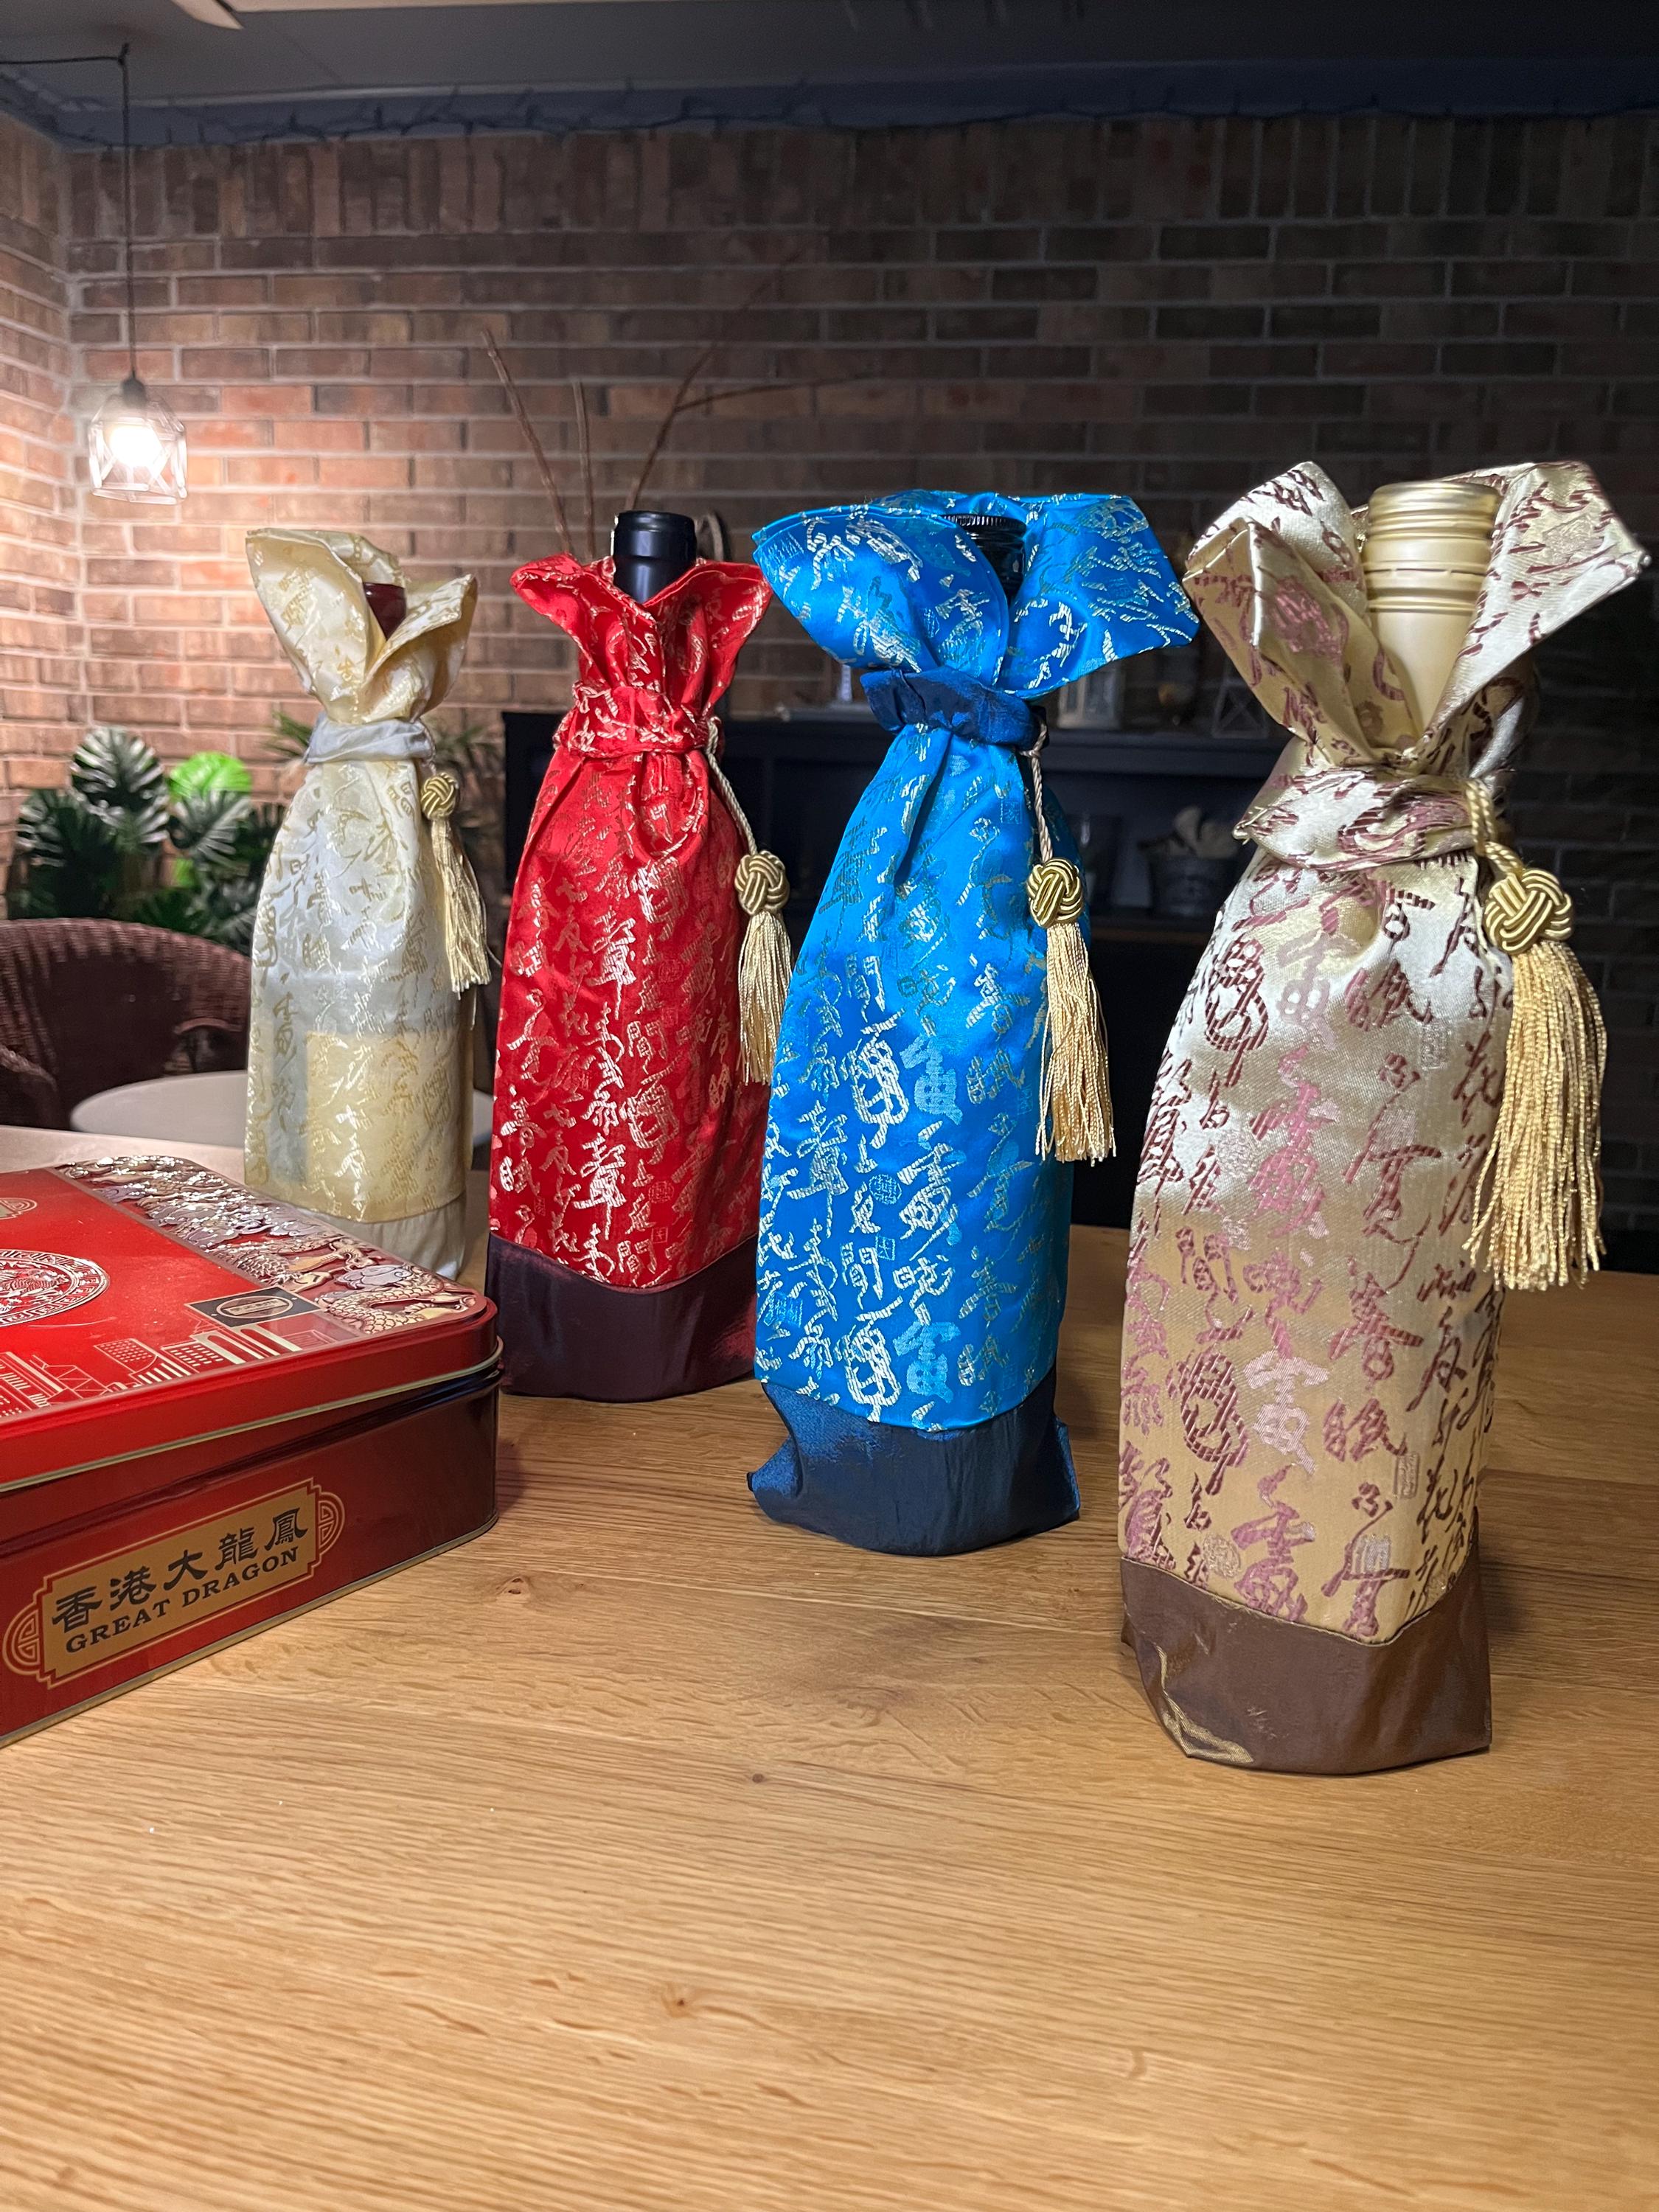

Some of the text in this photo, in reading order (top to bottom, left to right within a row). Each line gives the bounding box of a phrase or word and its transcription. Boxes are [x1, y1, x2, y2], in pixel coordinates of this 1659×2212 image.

[52, 1507, 309, 1633] 香港大龍鳳
[66, 1546, 299, 1653] GREAT DRAGON
